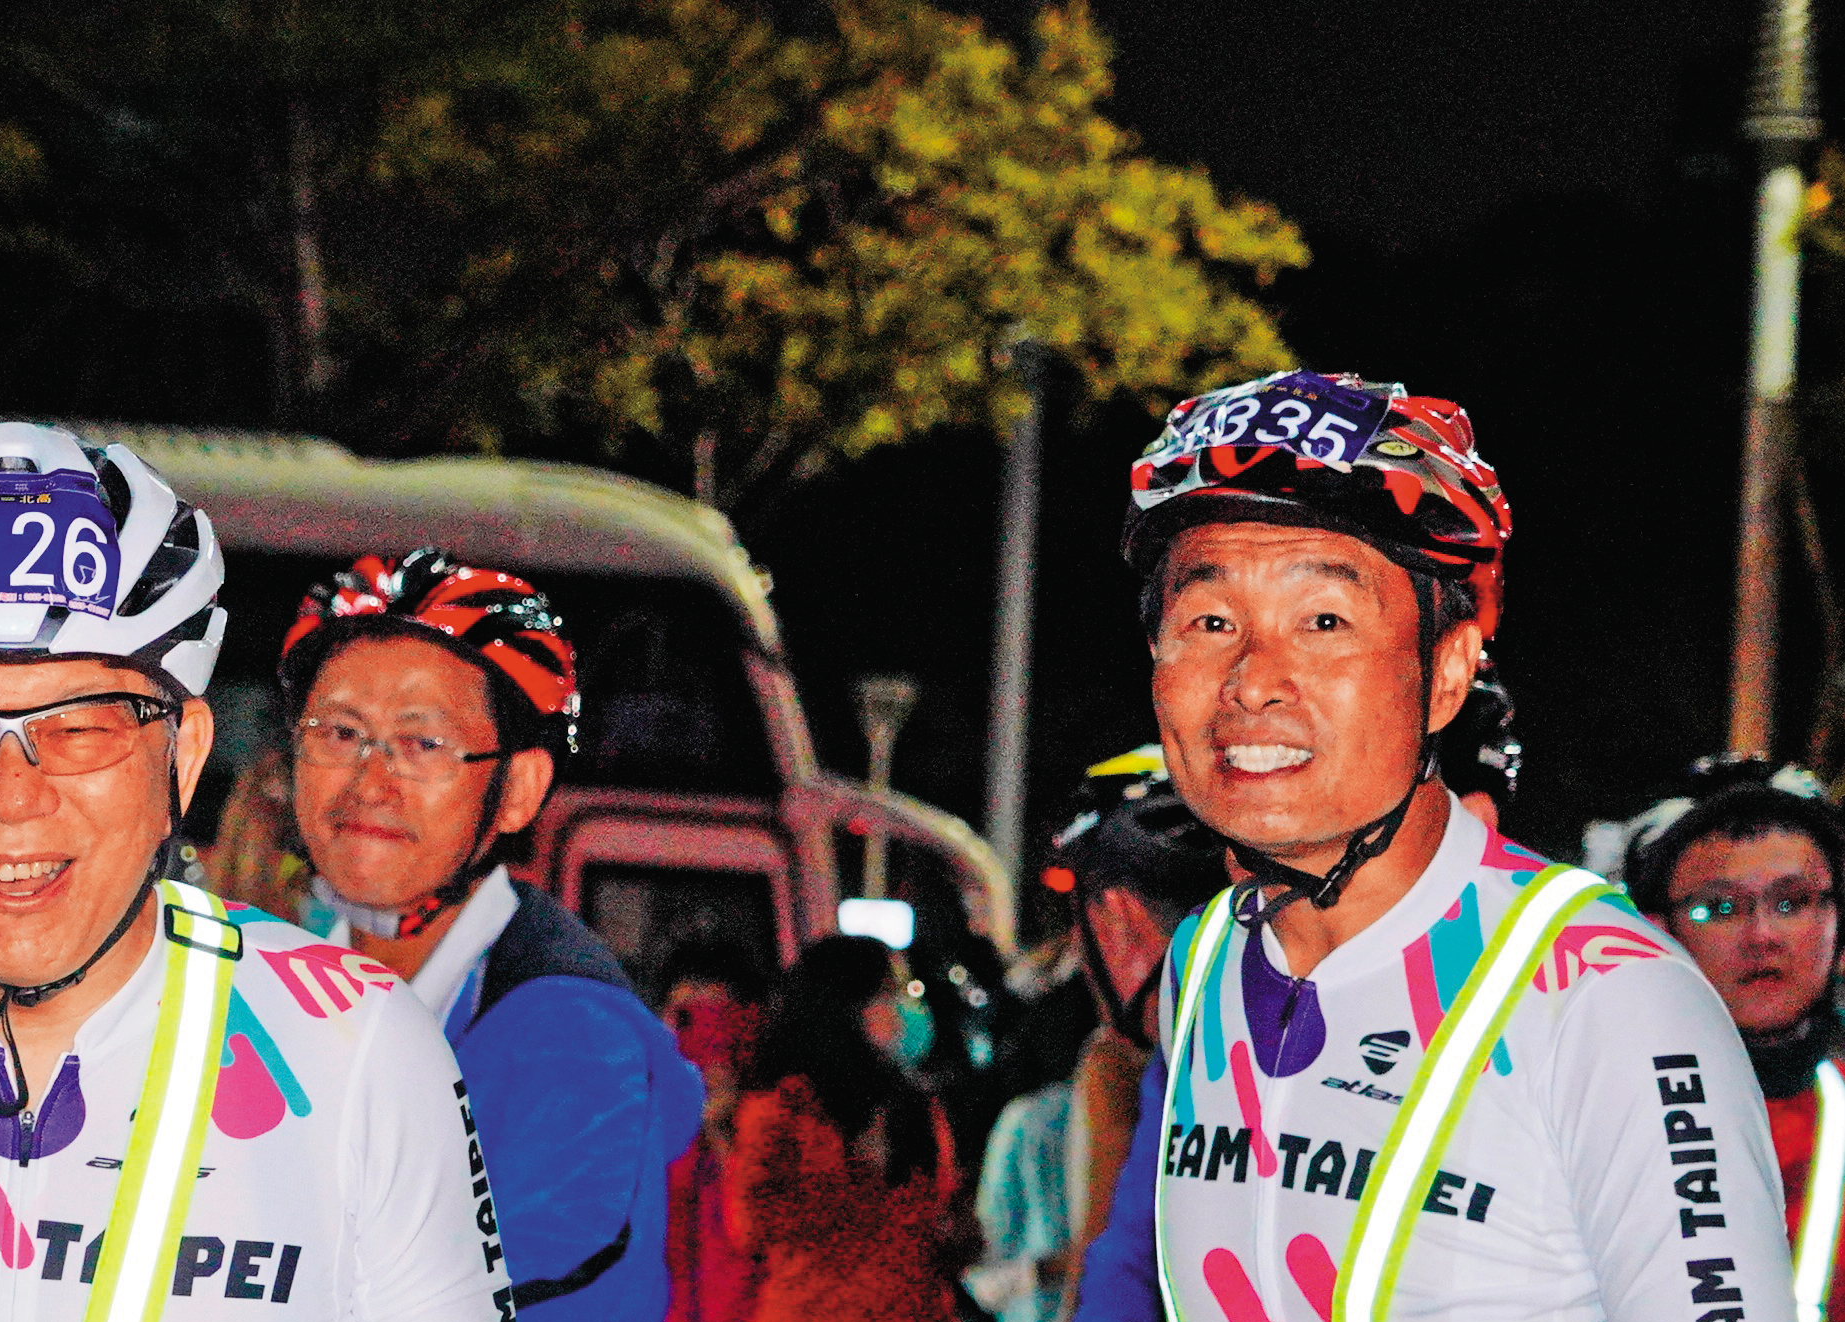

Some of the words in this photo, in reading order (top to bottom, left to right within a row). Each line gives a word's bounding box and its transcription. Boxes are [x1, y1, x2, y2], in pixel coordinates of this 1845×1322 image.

[1164, 1124, 1252, 1183] EAM
[1277, 1133, 1497, 1223] TAIEI
[1652, 1053, 1727, 1240] TAIPEI
[36, 1219, 302, 1304] TPEI
